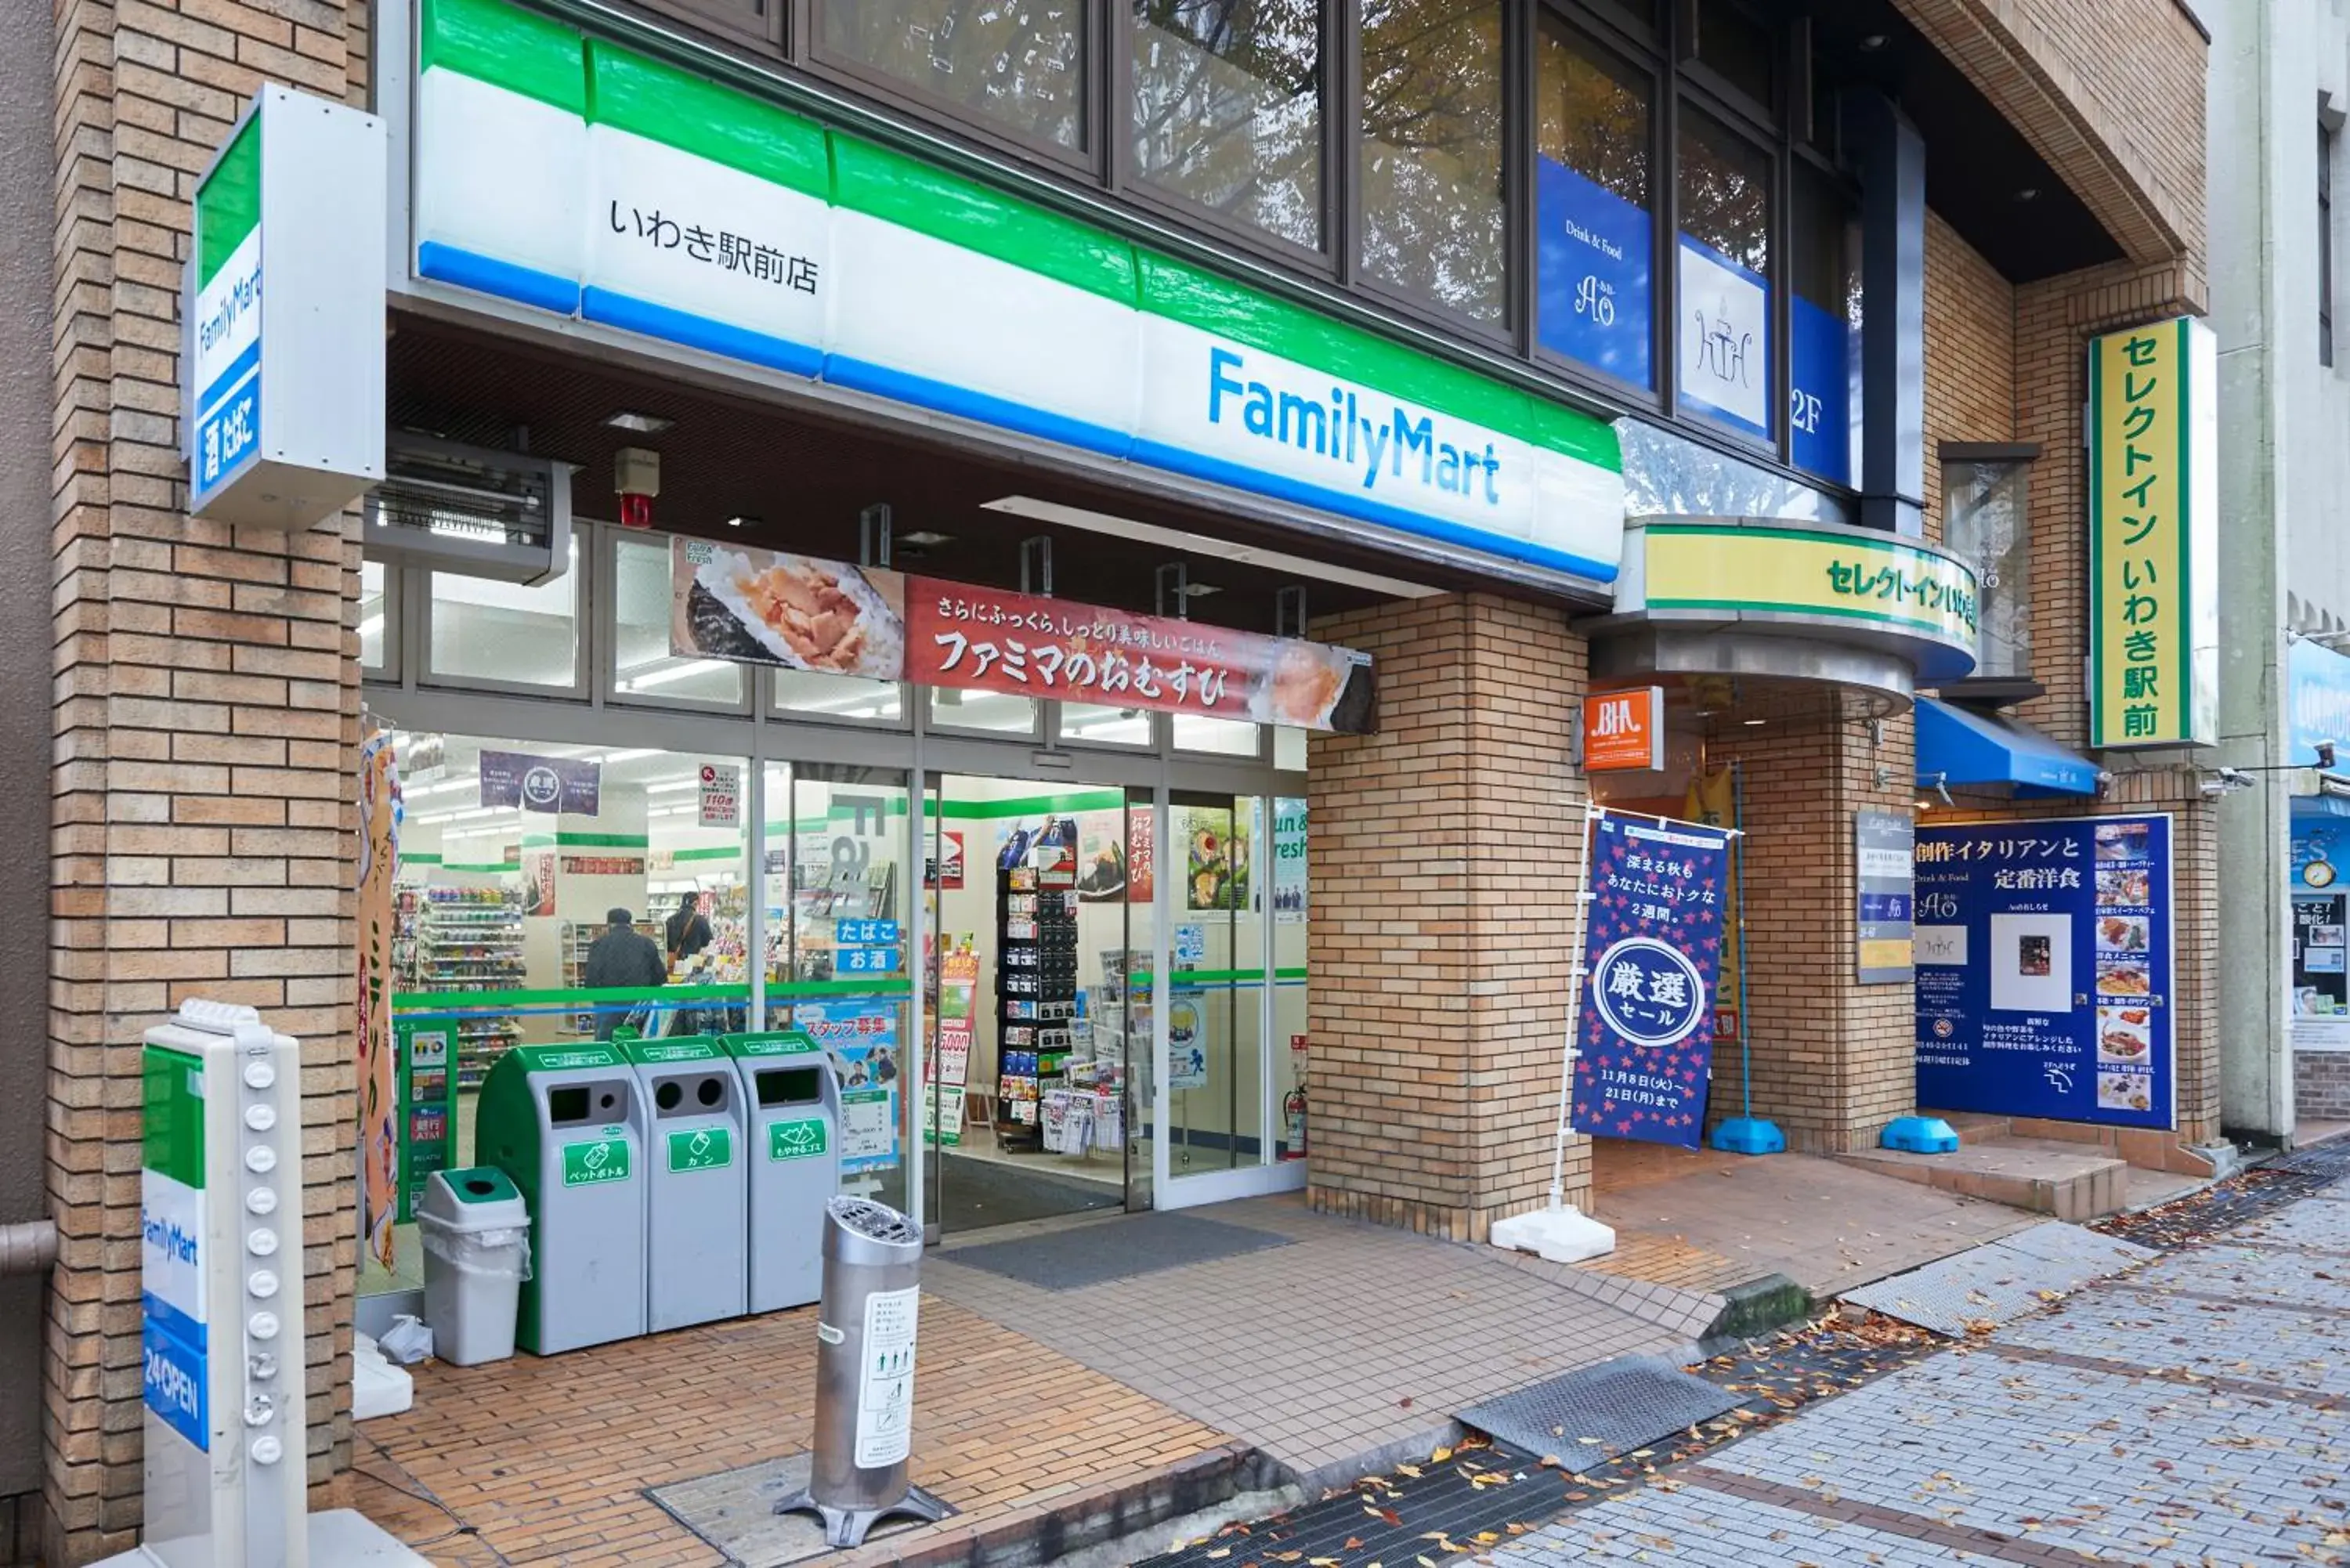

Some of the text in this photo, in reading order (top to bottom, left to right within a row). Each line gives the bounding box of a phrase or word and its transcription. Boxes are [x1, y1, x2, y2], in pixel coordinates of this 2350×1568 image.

[610, 200, 819, 294] いわき駅前店
[1567, 219, 1622, 261] Drink & Food
[200, 263, 261, 357] FamilyMart
[1209, 346, 1500, 504] FamilyMart
[1791, 387, 1822, 434] 2F
[222, 396, 253, 463] たばこ
[2121, 336, 2158, 737] セレクトインいわき駅前
[938, 596, 1227, 661] さらにふっくら、しっとり美味しいごはん。
[935, 630, 1227, 706] ファミマのおむすび
[2296, 675, 2350, 740] LOURD
[1274, 815, 1296, 833] un
[1274, 836, 1307, 859] resh
[1916, 837, 2080, 862] 創作イタリアンと
[1627, 854, 1693, 878] 深まる秋も
[1994, 867, 2081, 889] 定番洋食
[1608, 873, 1716, 904] あなたにおトクな
[1632, 903, 1679, 923] 2週間。
[841, 923, 894, 941] たばこ
[850, 952, 887, 969] お酒
[1607, 961, 1688, 1008] 厳選
[806, 1017, 887, 1036] スタッフ募集
[1619, 1002, 1676, 1026] セール
[1606, 1087, 1679, 1109] 21日(月)まで
[569, 1166, 624, 1181] ペットボトル
[143, 1209, 198, 1266] FamilyMart
